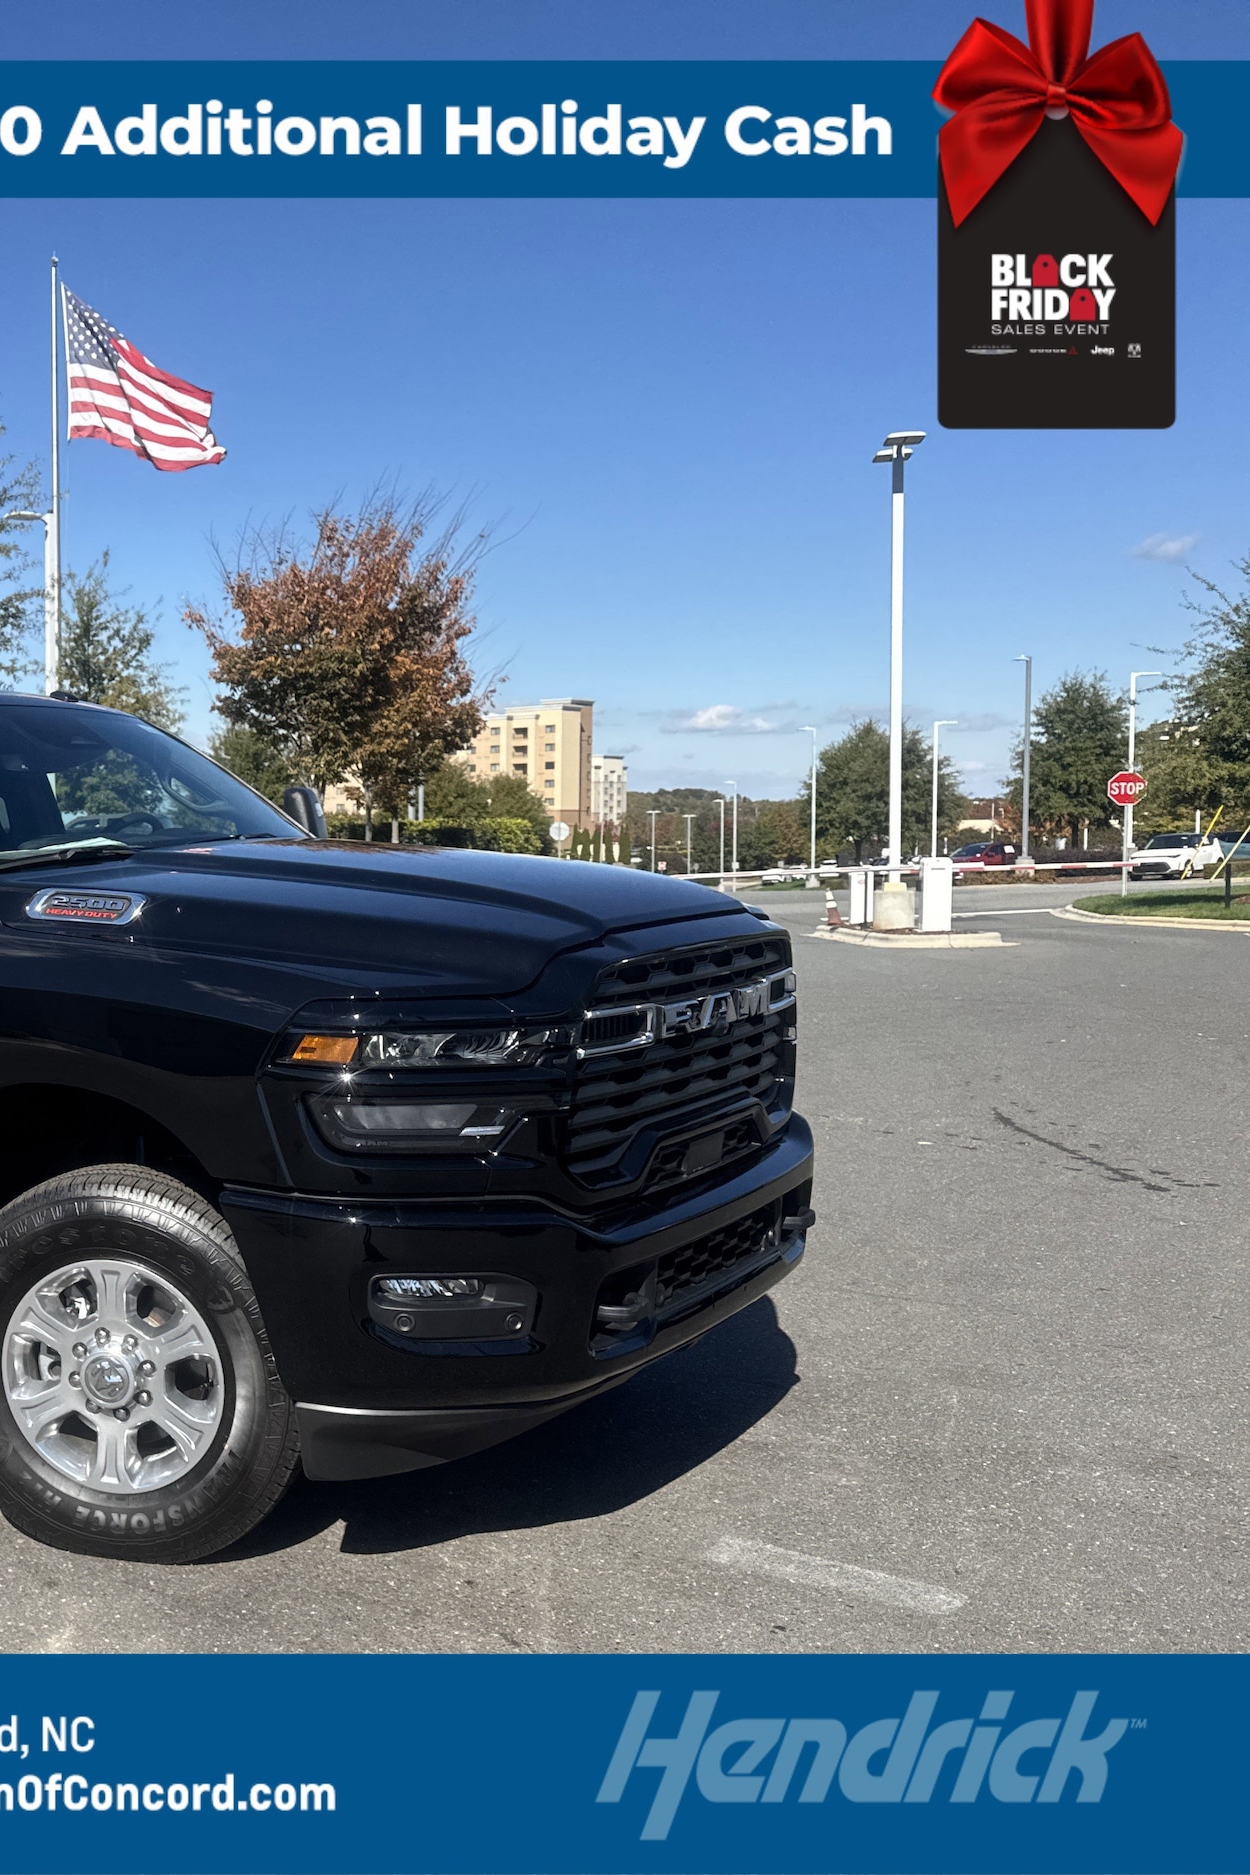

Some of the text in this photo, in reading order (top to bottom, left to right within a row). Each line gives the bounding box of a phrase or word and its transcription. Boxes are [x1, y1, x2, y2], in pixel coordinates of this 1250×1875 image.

[1111, 782, 1145, 795] STOP
[51, 895, 126, 911] 2500
[46, 908, 118, 919] HEAVY DUTY
[663, 980, 769, 1038] RAM
